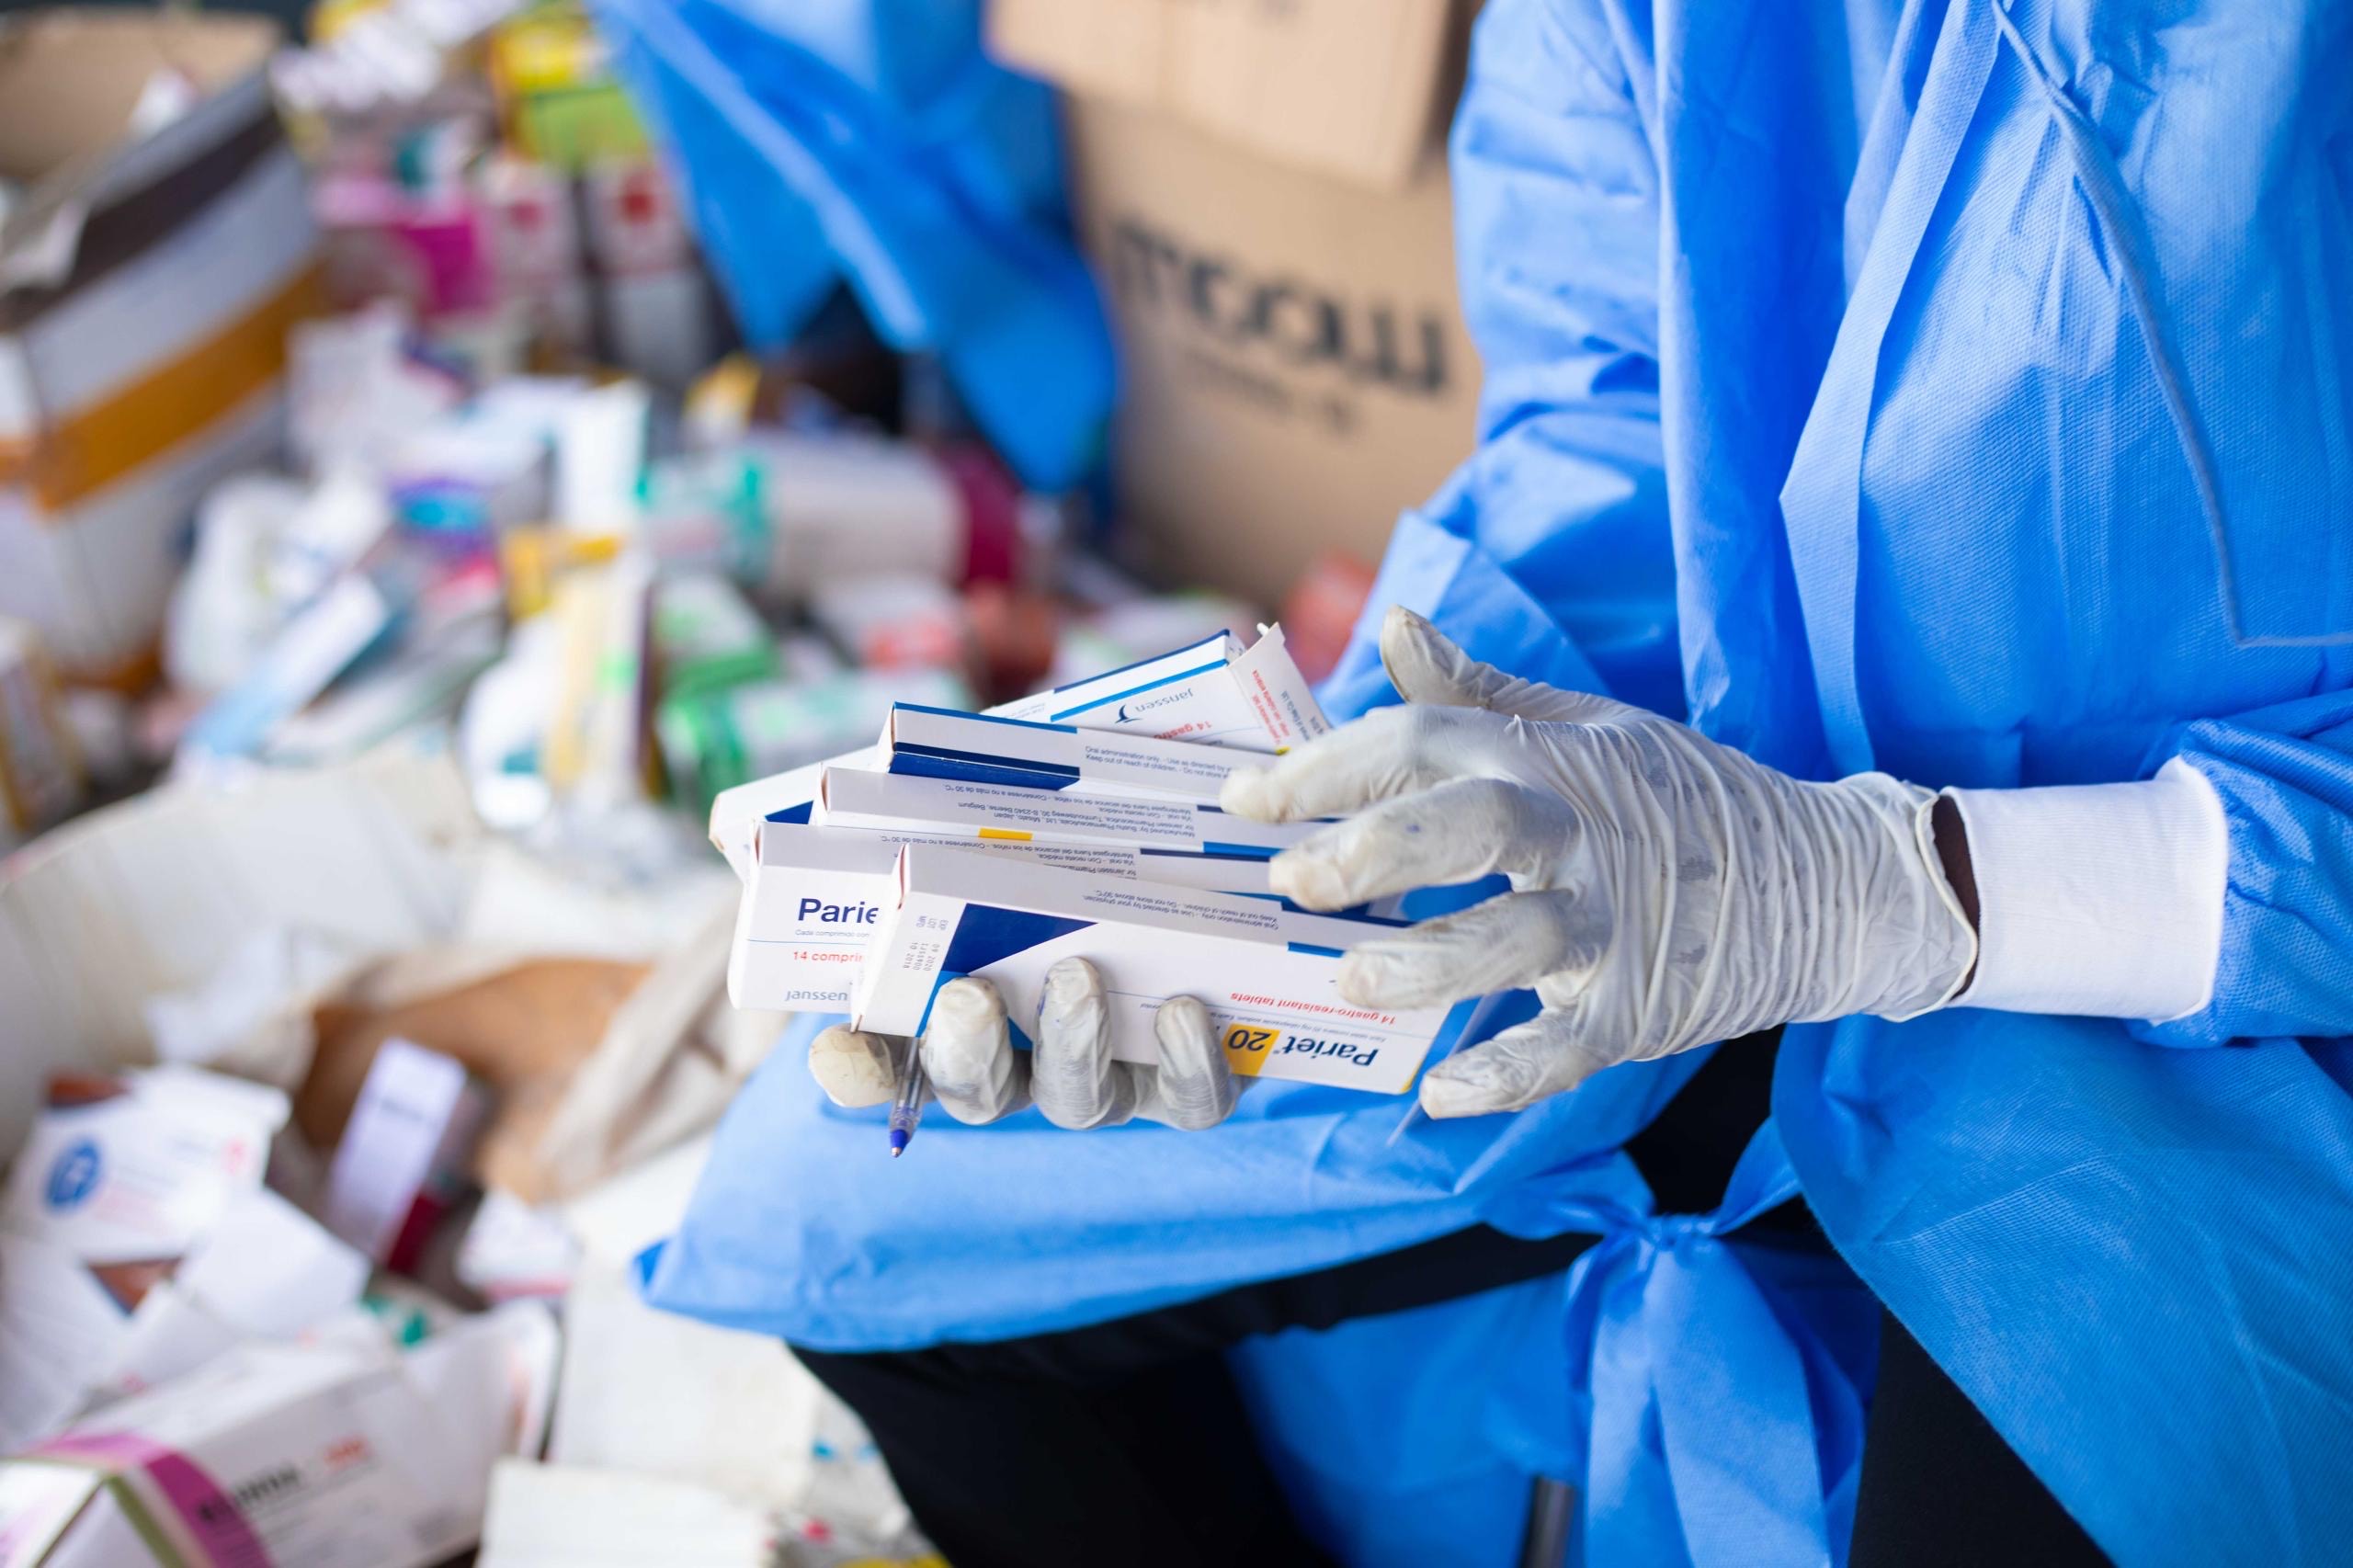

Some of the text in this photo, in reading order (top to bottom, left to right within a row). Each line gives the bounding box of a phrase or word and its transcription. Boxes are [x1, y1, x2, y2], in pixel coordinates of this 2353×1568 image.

[1197, 721, 1212, 731] 14
[797, 897, 879, 924] Parie
[926, 918, 937, 928] LOT
[793, 951, 807, 960] 14
[923, 956, 937, 971] 2020
[1230, 993, 1396, 1025] 14 gastro-resistant tablets
[1228, 1029, 1272, 1051] 20
